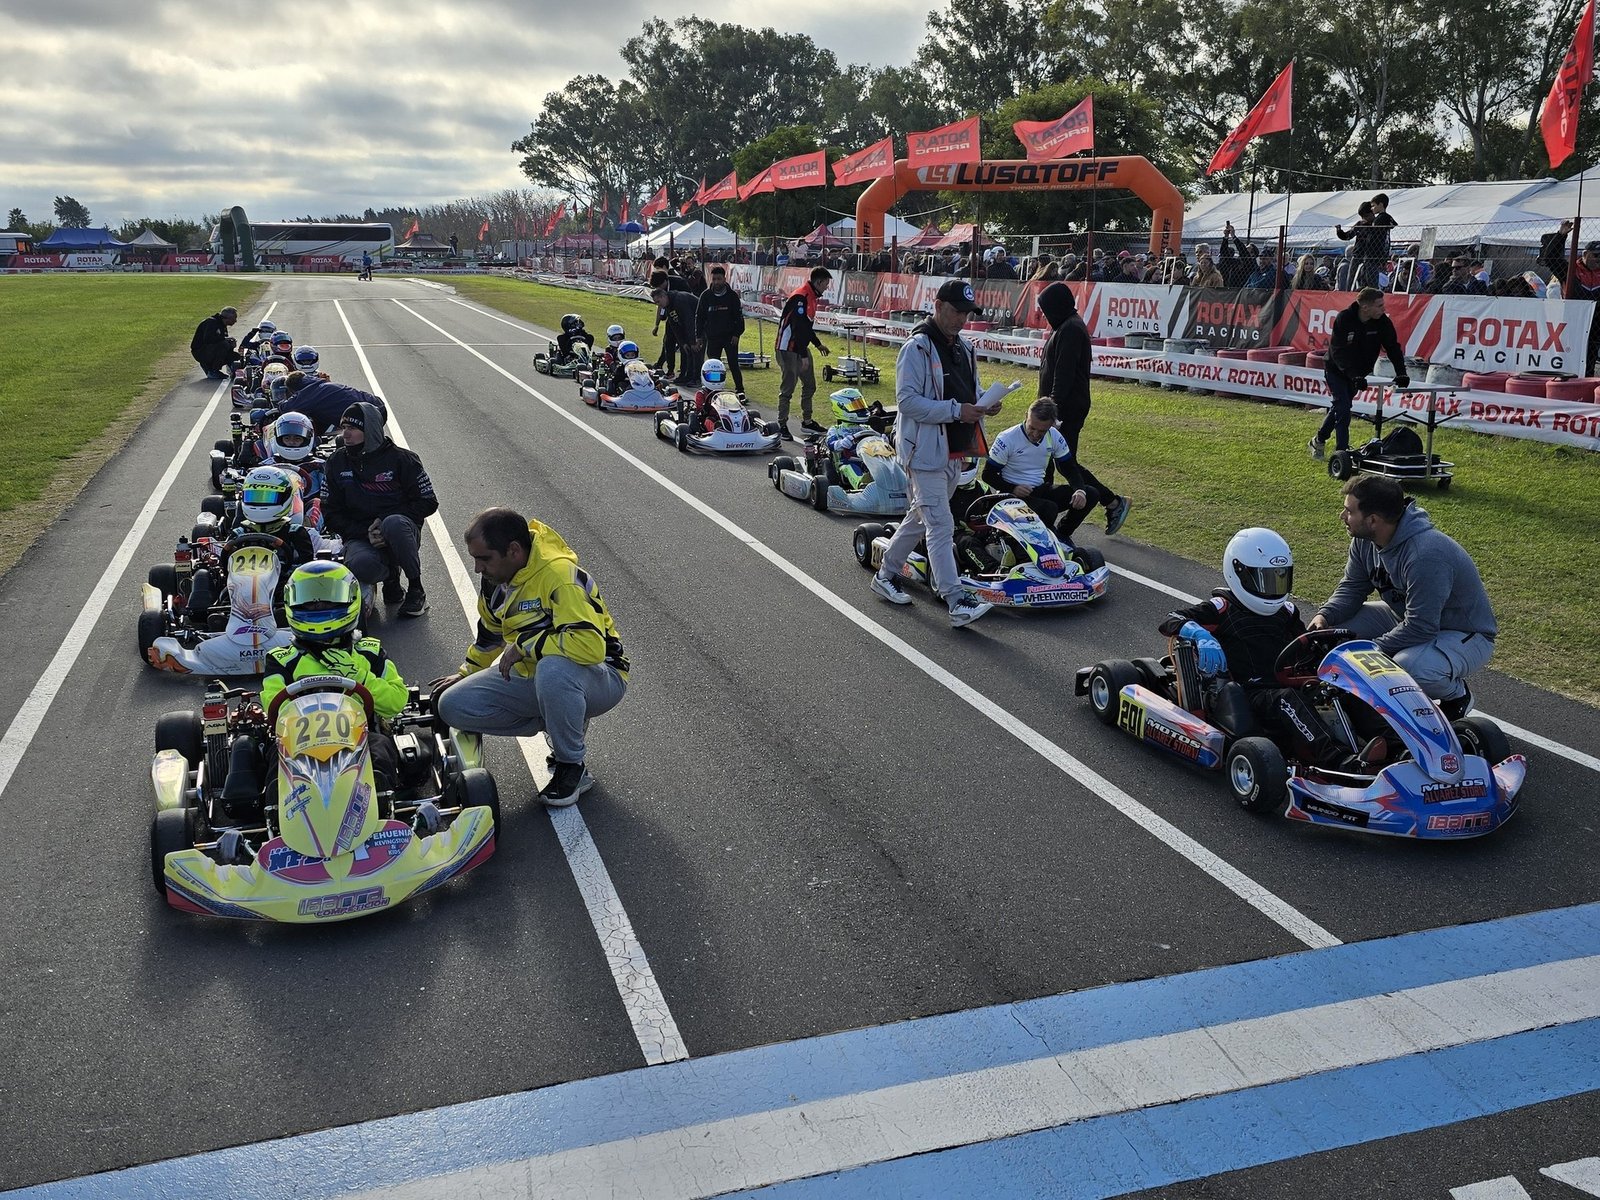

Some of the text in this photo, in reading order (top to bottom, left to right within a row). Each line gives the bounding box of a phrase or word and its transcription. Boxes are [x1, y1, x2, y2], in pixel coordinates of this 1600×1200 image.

[847, 293, 870, 302] RACING
[883, 283, 908, 299] ROTAX
[982, 308, 1011, 318] ACING
[1108, 297, 1160, 319] ROTAX
[1197, 301, 1261, 328] ROTAX
[1107, 318, 1160, 332] RACING
[1196, 325, 1260, 341] RACING
[1456, 317, 1567, 353] ROTAX
[984, 340, 1004, 352] ROTAX
[1454, 347, 1564, 369] RACING
[1098, 354, 1133, 370] ROTAX
[1136, 358, 1173, 375] ROTAX
[1178, 363, 1222, 382] ROTAX
[1228, 368, 1278, 389] ROTAX
[1399, 391, 1462, 416] ROTAX
[1470, 401, 1543, 429] ROTAX
[1553, 412, 1600, 438] ROT
[235, 554, 269, 572] 214
[1023, 591, 1087, 603] WHEELWRIGHT
[239, 649, 265, 657] KART
[1121, 699, 1143, 738] 201
[296, 713, 350, 745] 220
[1146, 726, 1172, 747] ALVAREZ
[1147, 718, 1201, 749] MOTOS
[1424, 788, 1460, 803] ALVAREZ
[1307, 804, 1340, 817] MUNDO
[375, 837, 410, 847] KEVINGSTON
[315, 897, 390, 918] COMPETICION
